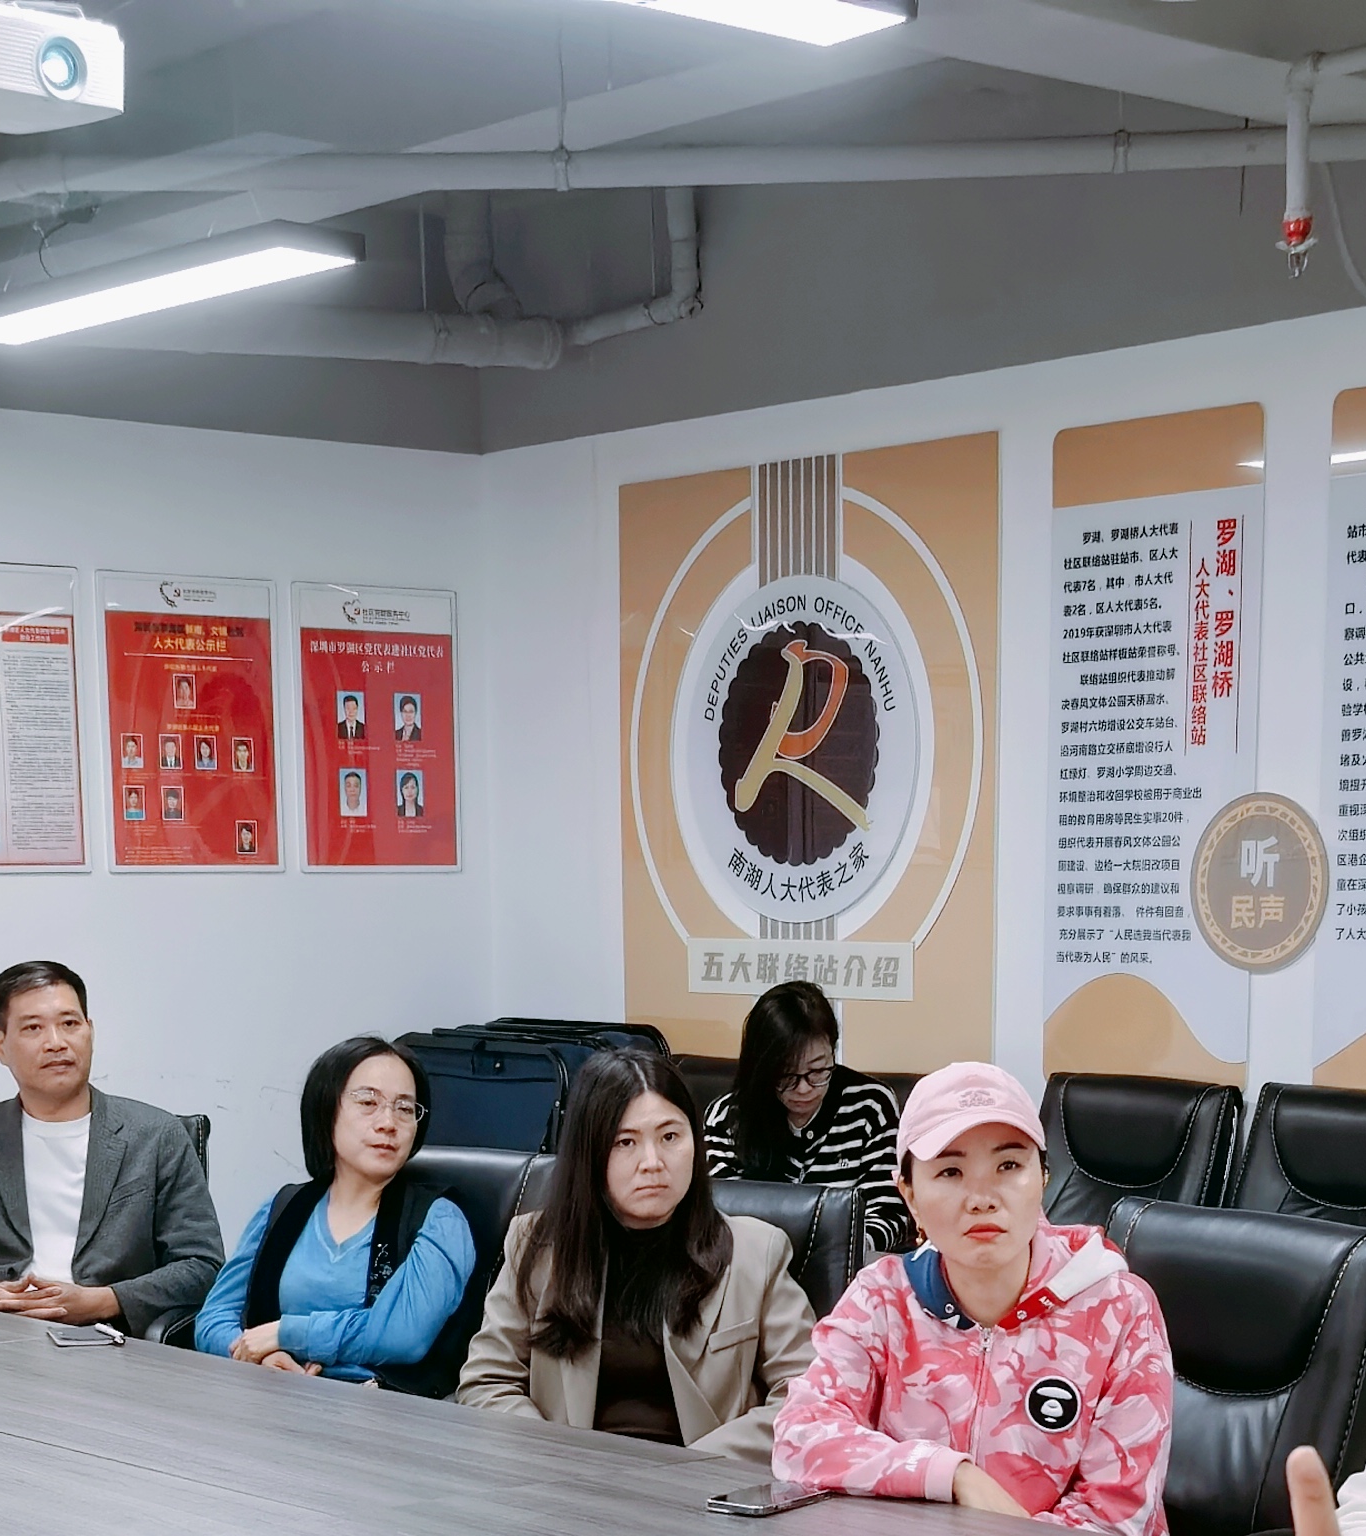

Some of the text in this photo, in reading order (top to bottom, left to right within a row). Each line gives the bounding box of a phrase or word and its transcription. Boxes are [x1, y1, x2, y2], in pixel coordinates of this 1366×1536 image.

[704, 594, 896, 722] DEPUTIES LIAISON OFFICE NANHU
[1190, 557, 1210, 746] 人大代表社区联络站
[727, 841, 870, 903] 南湖人大代表之家
[1241, 836, 1281, 888] 听
[1230, 894, 1286, 929] 民声
[701, 951, 900, 988] 五大联络站介绍
